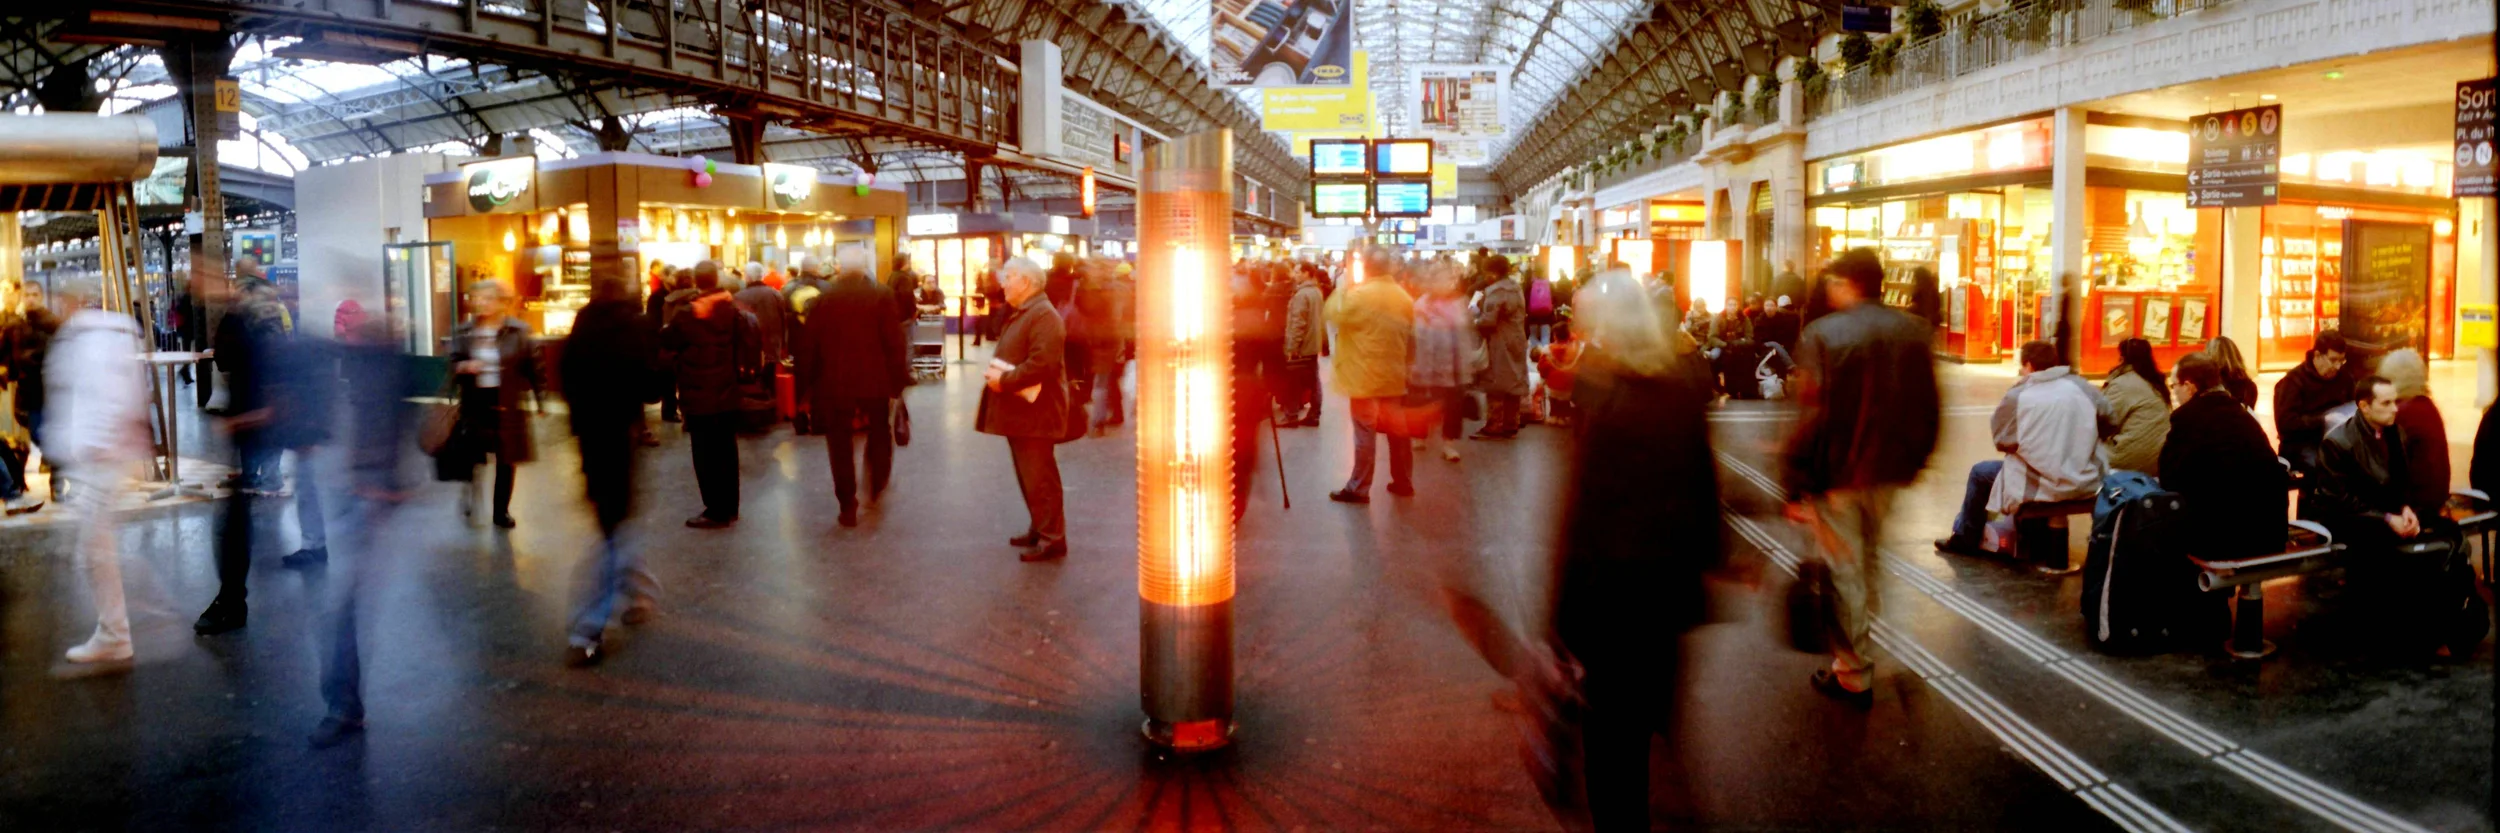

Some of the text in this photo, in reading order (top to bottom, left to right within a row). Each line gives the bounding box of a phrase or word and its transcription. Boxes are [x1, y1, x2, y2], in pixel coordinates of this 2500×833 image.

[1316, 67, 1342, 75] IKEA
[217, 87, 237, 107] 12
[2471, 126, 2483, 139] du
[2202, 168, 2221, 179] Sortie
[2201, 189, 2221, 200] Sortie
